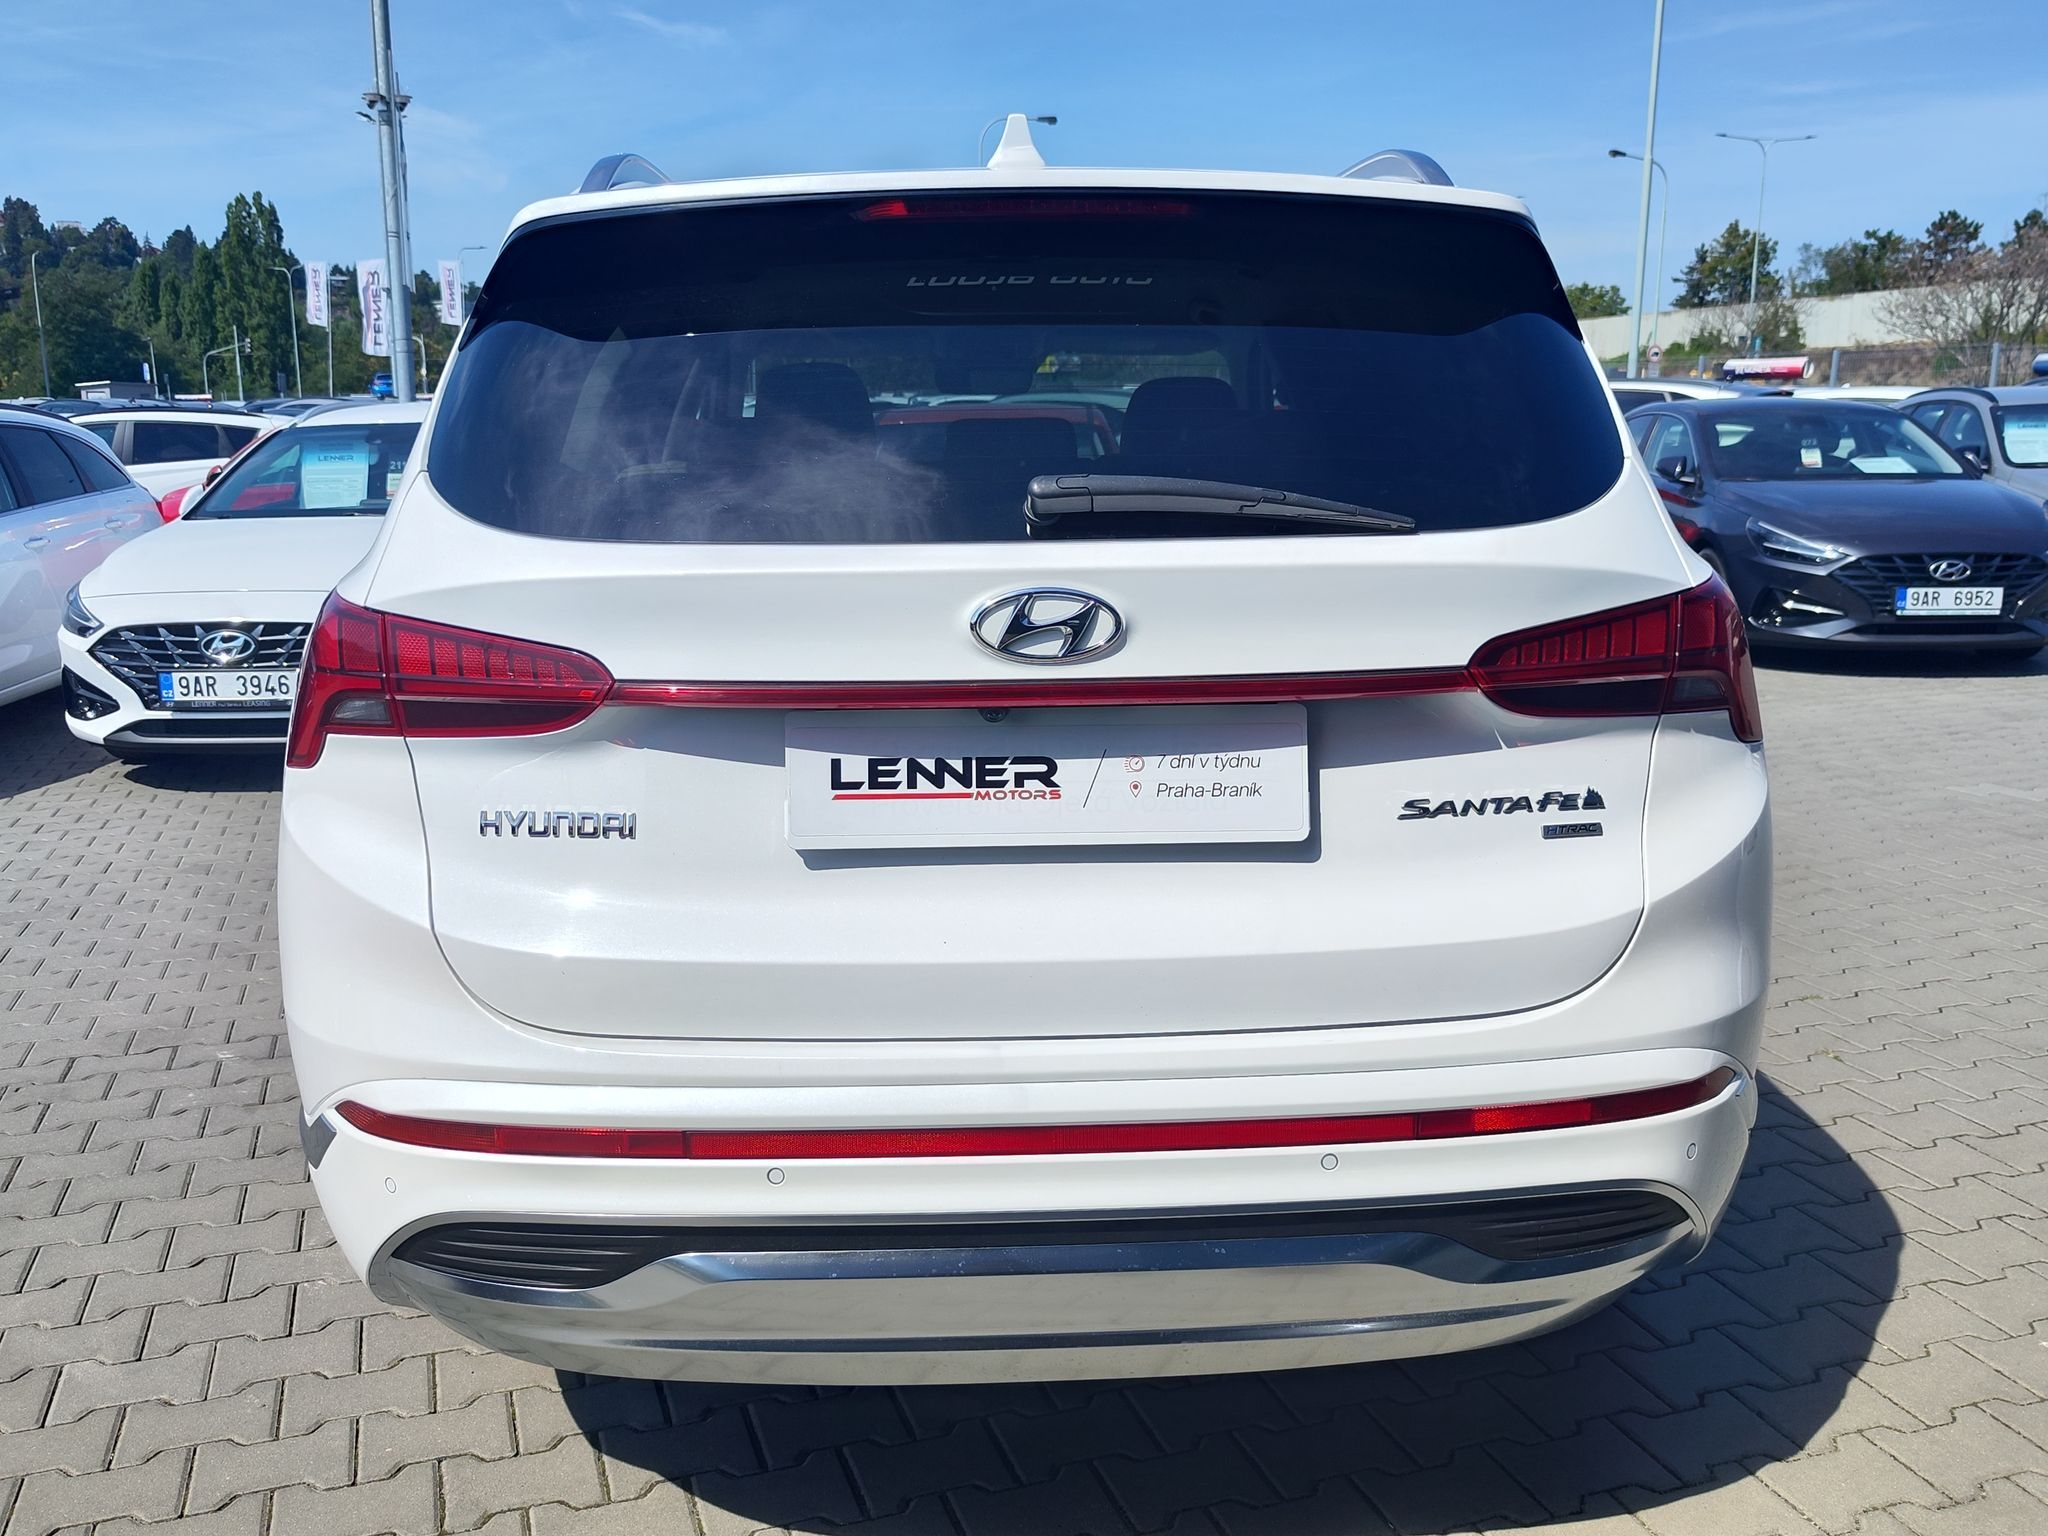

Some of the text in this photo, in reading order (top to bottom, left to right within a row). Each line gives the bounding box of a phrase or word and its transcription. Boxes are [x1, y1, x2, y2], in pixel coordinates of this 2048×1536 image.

[1911, 590, 1994, 607] 9AR 6952
[178, 675, 290, 697] 9AR 3946
[1157, 753, 1262, 772] 7 dní v týdnu
[830, 756, 1061, 790] LENNER
[974, 789, 1062, 801] MOTORS
[1156, 782, 1263, 798] Praha-Braník
[1397, 796, 1535, 820] SANTA
[479, 810, 637, 840] HYUNDAI
[1546, 823, 1599, 834] HTRAC
